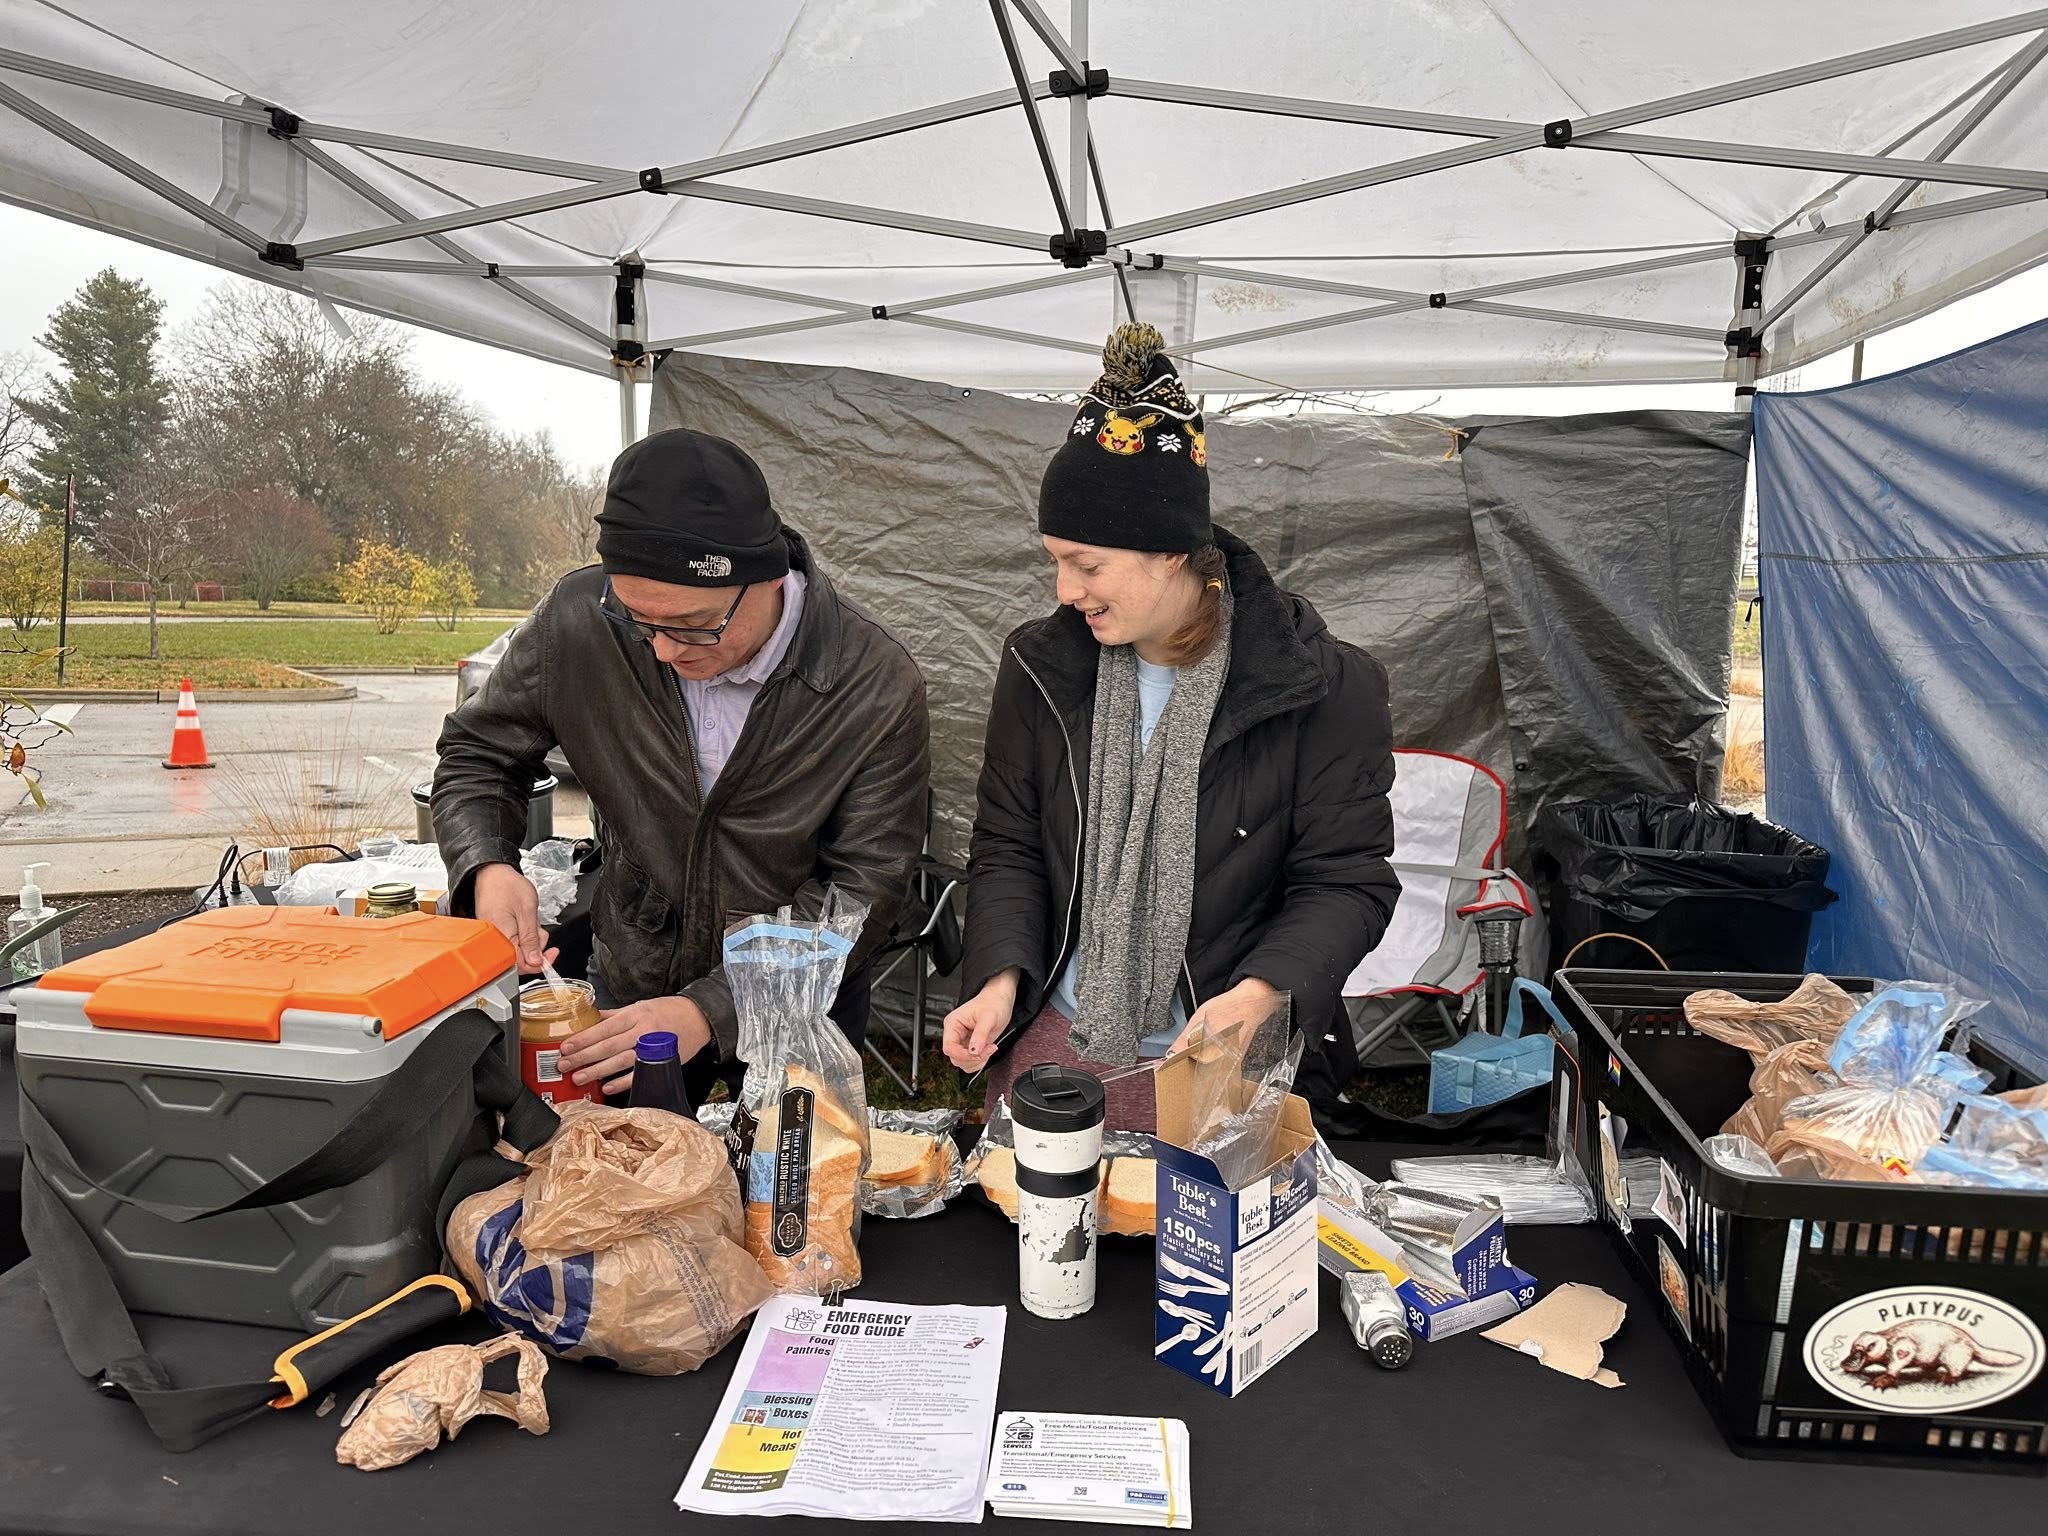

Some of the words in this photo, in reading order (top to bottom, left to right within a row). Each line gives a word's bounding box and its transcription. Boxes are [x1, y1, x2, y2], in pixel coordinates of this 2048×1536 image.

[688, 560, 720, 569] NORTH
[705, 554, 722, 562] THE
[697, 568, 719, 577] FACE
[782, 1128, 792, 1151] WHITE
[779, 1152, 790, 1180] RUSTIC
[1169, 1174, 1217, 1208] Table's
[1240, 1202, 1269, 1225] Table's
[1331, 1232, 1353, 1247] SHEETS
[1162, 1232, 1185, 1249] Plastic
[1186, 1243, 1210, 1260] Cutlery
[1212, 1255, 1224, 1267] Set
[1326, 1235, 1350, 1254] LEADING
[1349, 1250, 1370, 1266] BRAND
[1519, 1286, 1535, 1302] 30
[827, 1310, 912, 1326] EMERGENCY
[1408, 1306, 1425, 1326] 30
[1878, 1301, 1984, 1327] PLATYPUS
[823, 1323, 860, 1335] FOOD
[864, 1326, 906, 1337] GUIDE
[809, 1335, 836, 1346] Food
[785, 1346, 831, 1356] Pantries
[763, 1395, 813, 1406] Blessing
[773, 1407, 809, 1419] Boxes
[781, 1430, 802, 1440] Hot
[760, 1442, 797, 1452] Meals
[1003, 1450, 1093, 1459] Transitional/Emergency
